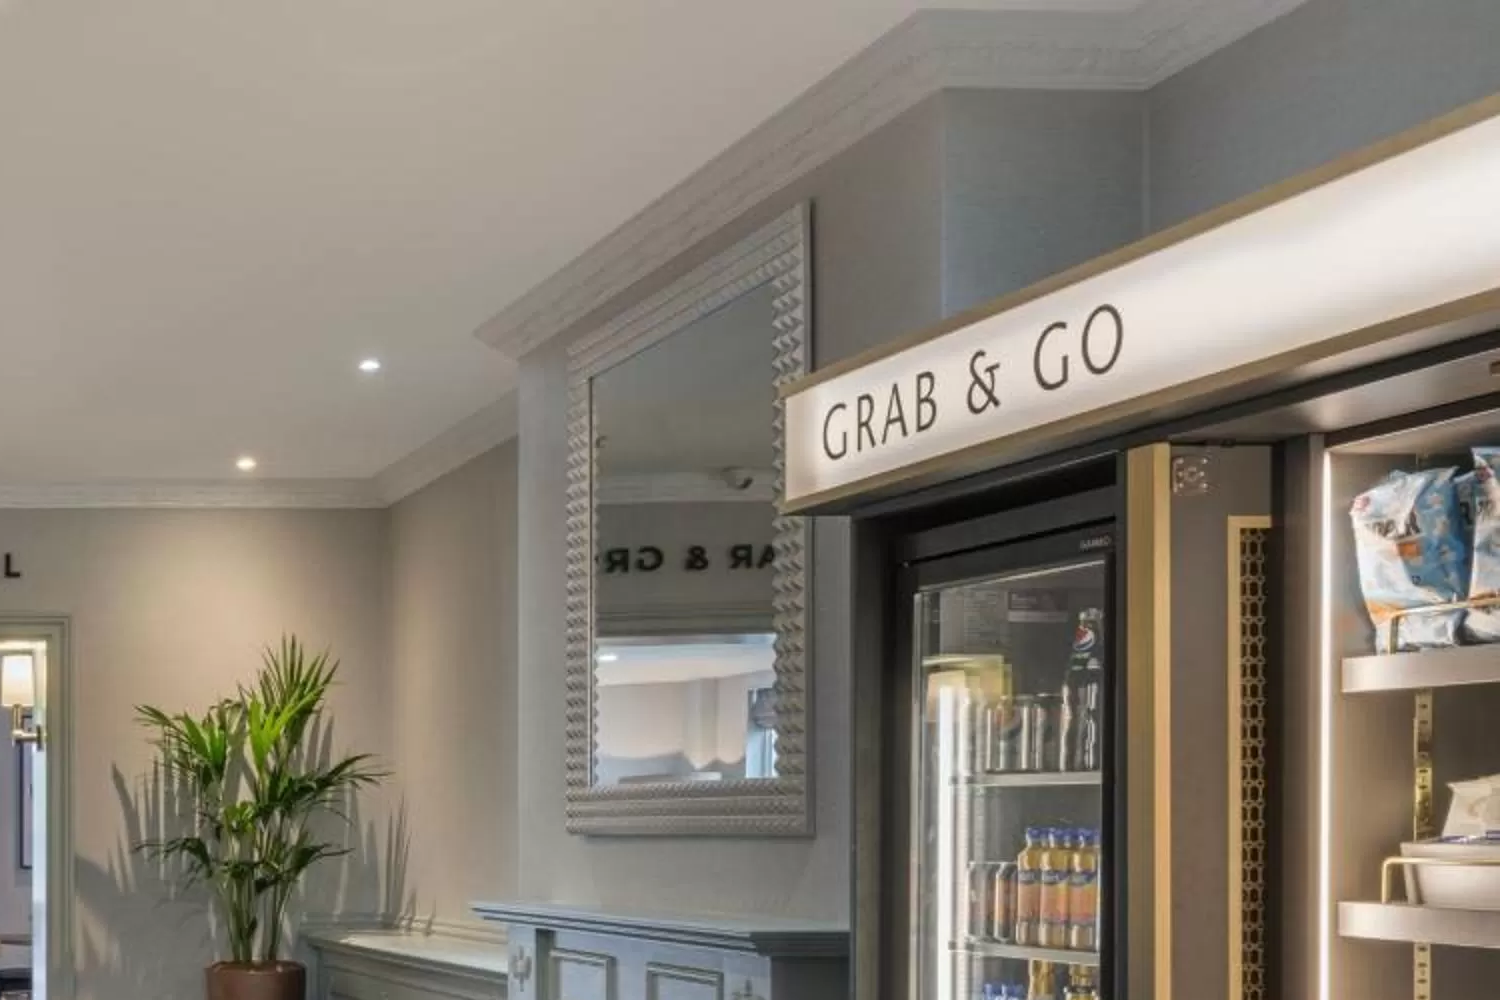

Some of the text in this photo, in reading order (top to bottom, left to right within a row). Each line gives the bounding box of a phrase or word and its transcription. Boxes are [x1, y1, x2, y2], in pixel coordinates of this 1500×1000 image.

[822, 303, 1124, 461] GRAB & GO
